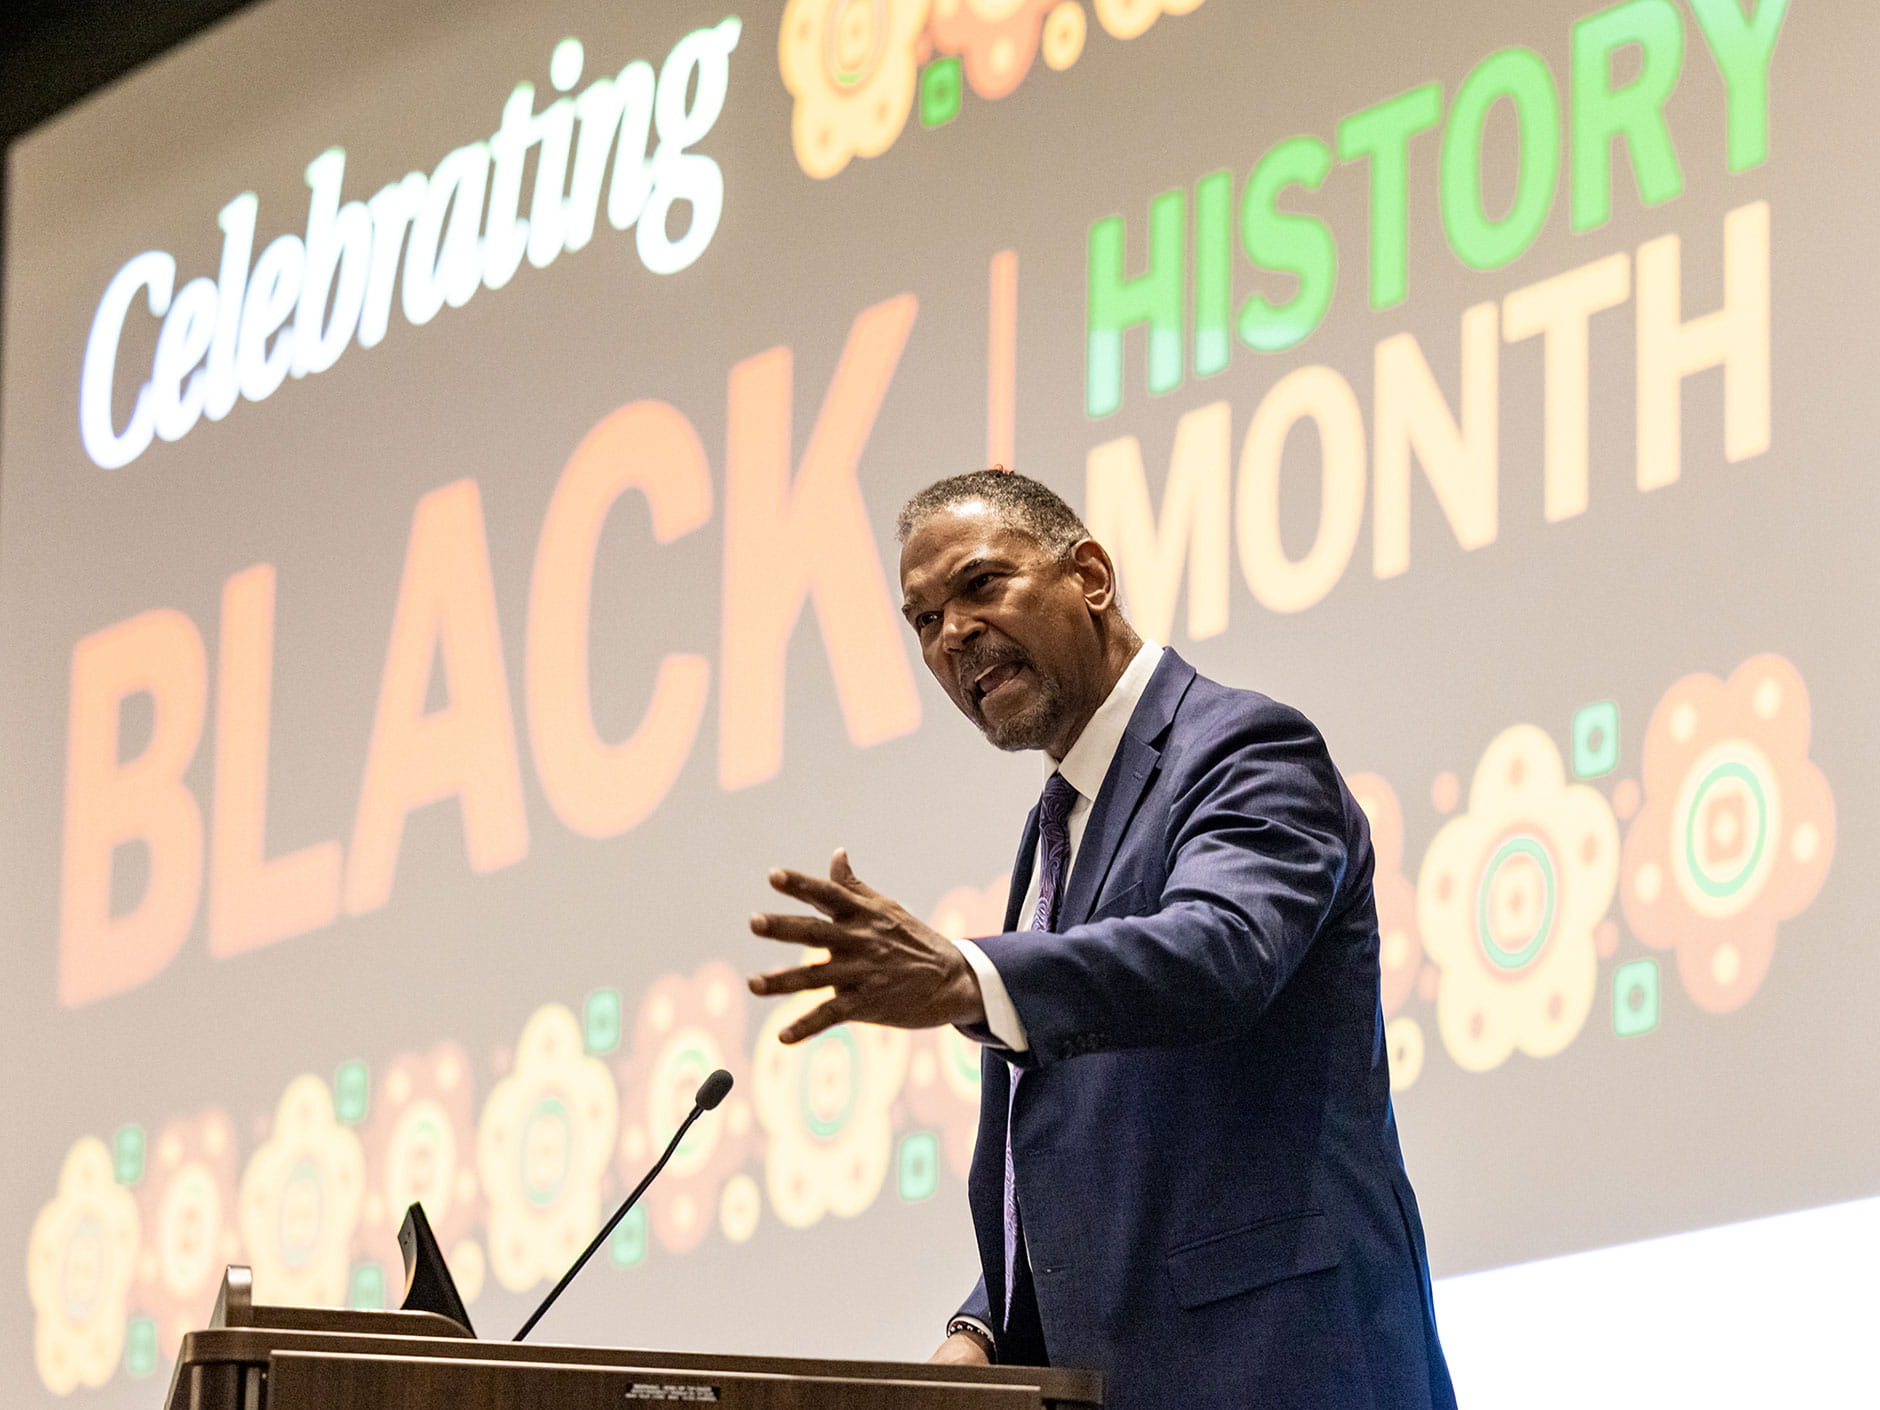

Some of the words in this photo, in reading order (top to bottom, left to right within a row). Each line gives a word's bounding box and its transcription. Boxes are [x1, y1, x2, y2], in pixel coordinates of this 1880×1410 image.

[79, 15, 742, 469] Celebrating
[1086, 0, 1792, 418] HISTORY
[1086, 200, 1772, 647] MONTH
[58, 293, 922, 1009] BLACK
